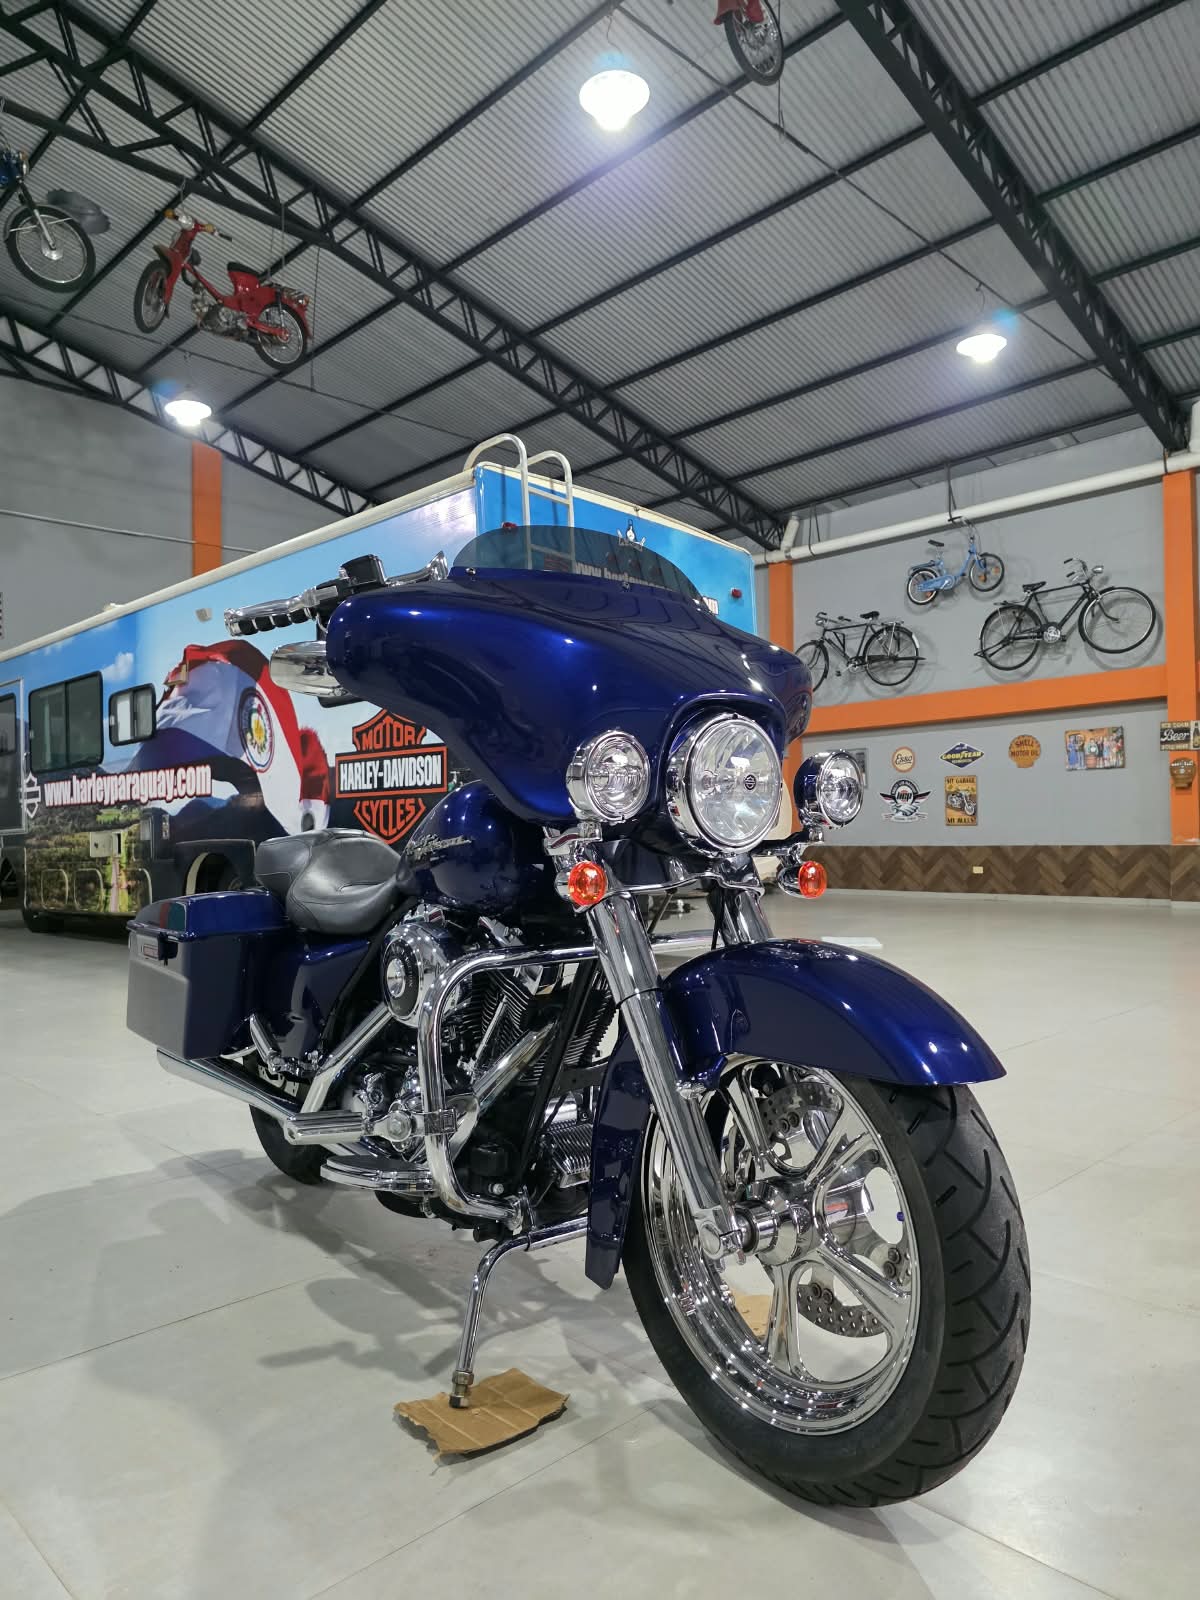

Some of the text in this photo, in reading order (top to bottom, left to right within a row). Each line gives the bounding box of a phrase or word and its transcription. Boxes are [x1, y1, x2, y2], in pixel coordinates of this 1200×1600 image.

[361, 715, 416, 751] MOTOR
[1160, 728, 1190, 742] Beer
[339, 754, 442, 791] HARLEY-DAVIDSON
[895, 753, 913, 765] Esso
[942, 750, 982, 761] GOODYEAR
[43, 764, 212, 807] www.harleyparaguay.com
[361, 798, 415, 837] CYCLES
